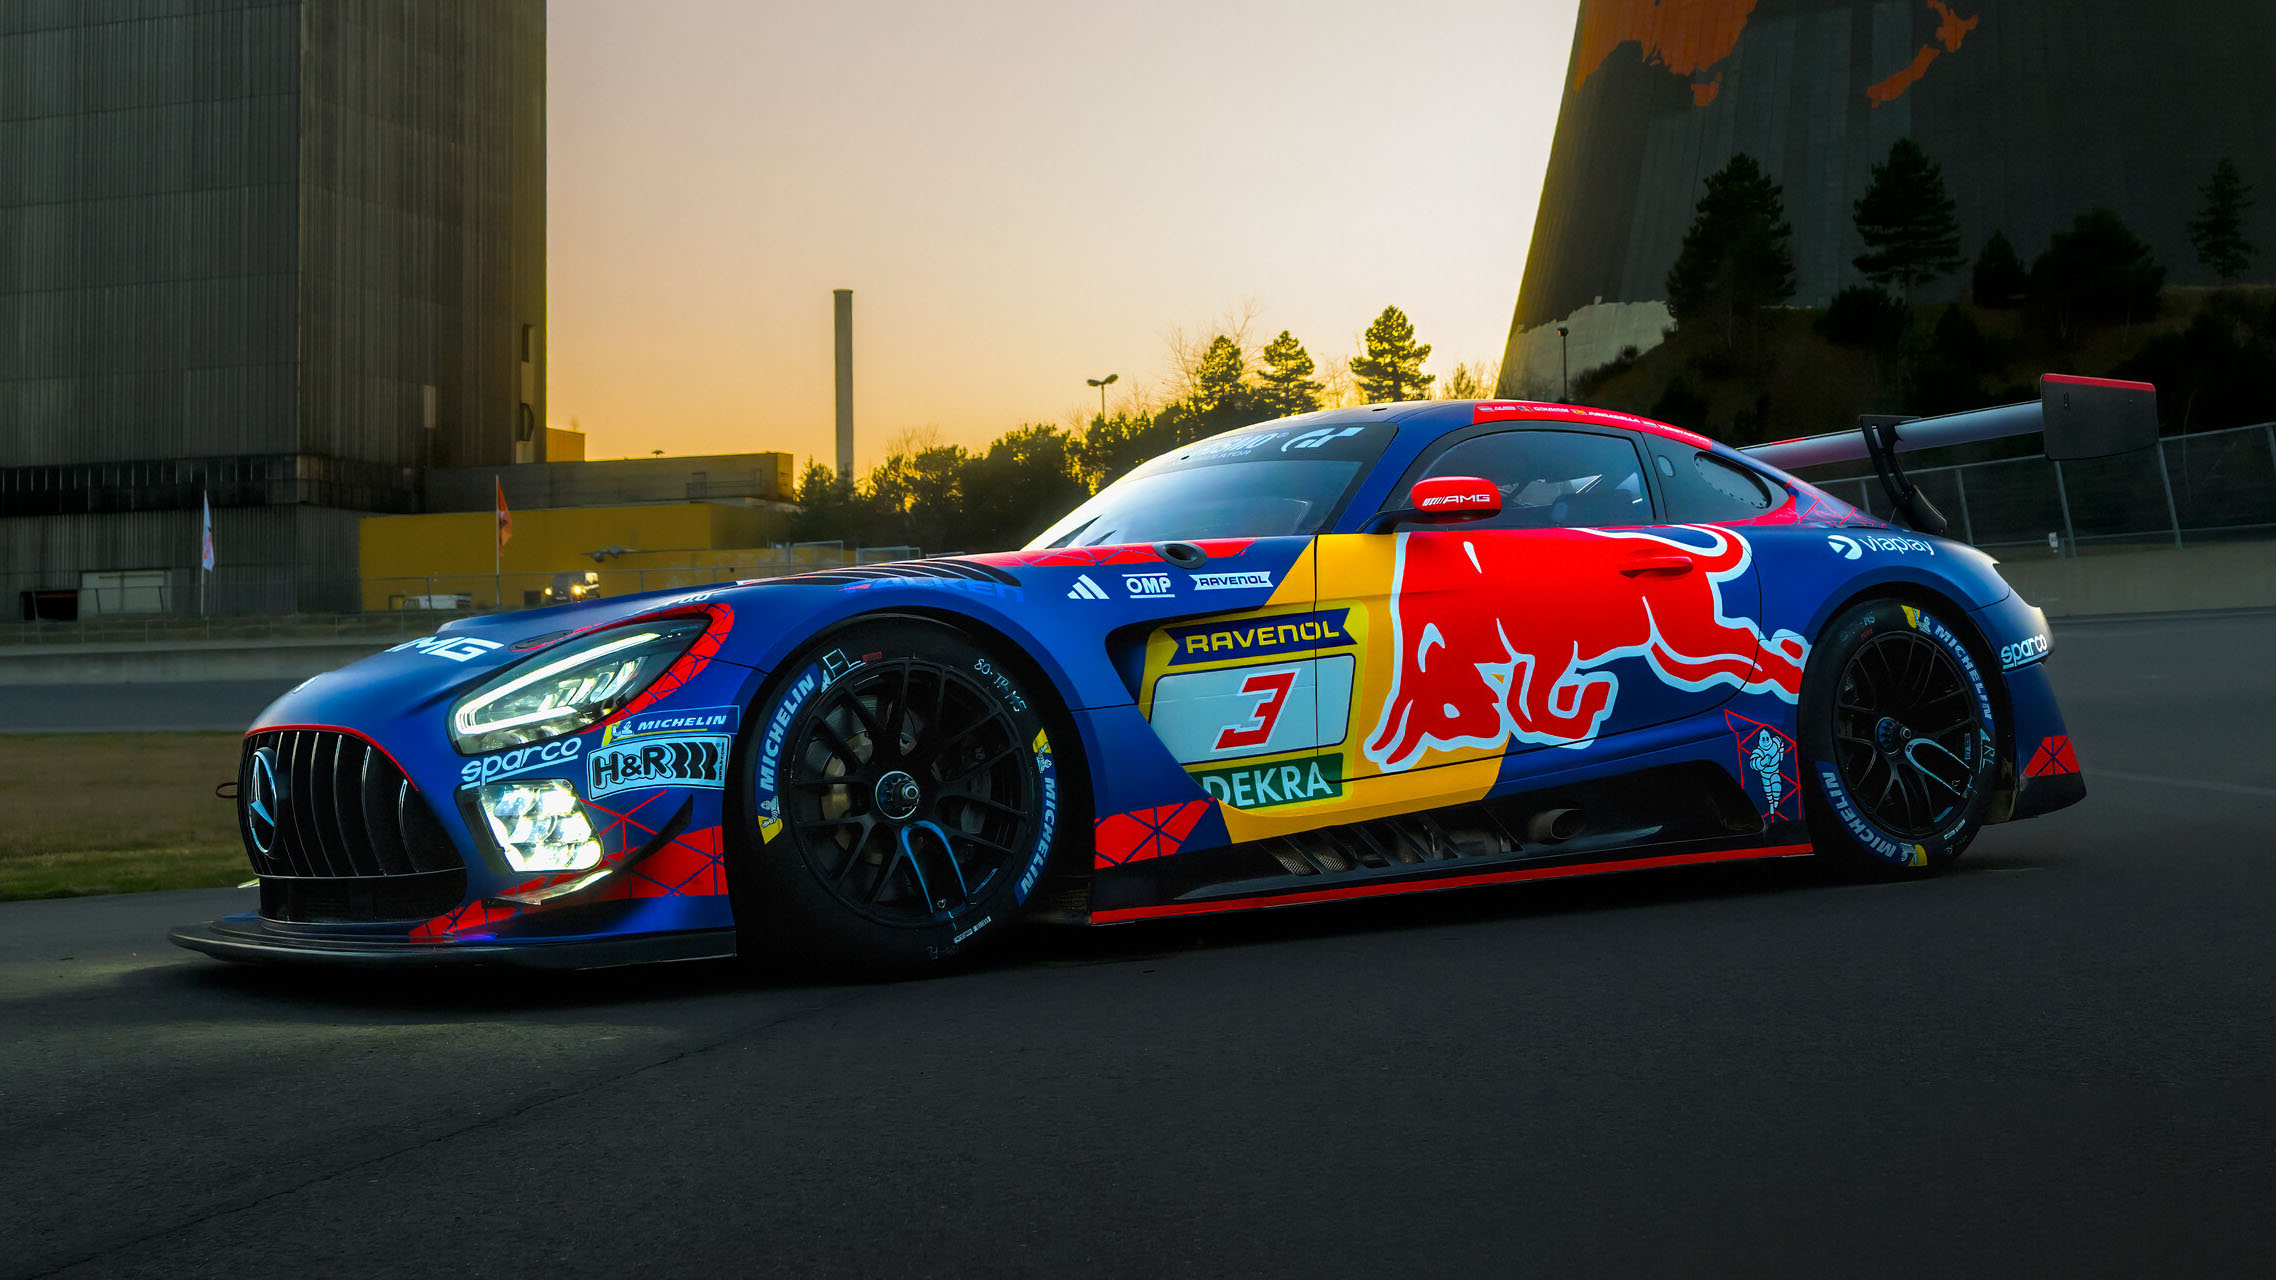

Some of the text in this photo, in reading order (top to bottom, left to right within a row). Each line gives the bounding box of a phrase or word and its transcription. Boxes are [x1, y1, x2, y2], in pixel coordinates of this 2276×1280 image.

[1443, 494, 1490, 504] AMG
[1860, 536, 1935, 556] viaplay
[1126, 577, 1171, 594] OMP
[1200, 575, 1267, 586] RAVENOL
[384, 636, 505, 663] MG
[1186, 620, 1340, 653] RAVENOL
[2001, 634, 2048, 667] sparco
[1935, 625, 1992, 720] MICHELIN
[638, 715, 727, 731] MICHELIN
[1213, 670, 1298, 752] 3
[760, 673, 815, 792] MICHELIN
[461, 737, 582, 789] sparco
[594, 745, 670, 789] H&R
[1202, 761, 1334, 808] DEKRA
[1822, 771, 1896, 858] MICHELIN
[1020, 778, 1056, 895] MICHELIN
